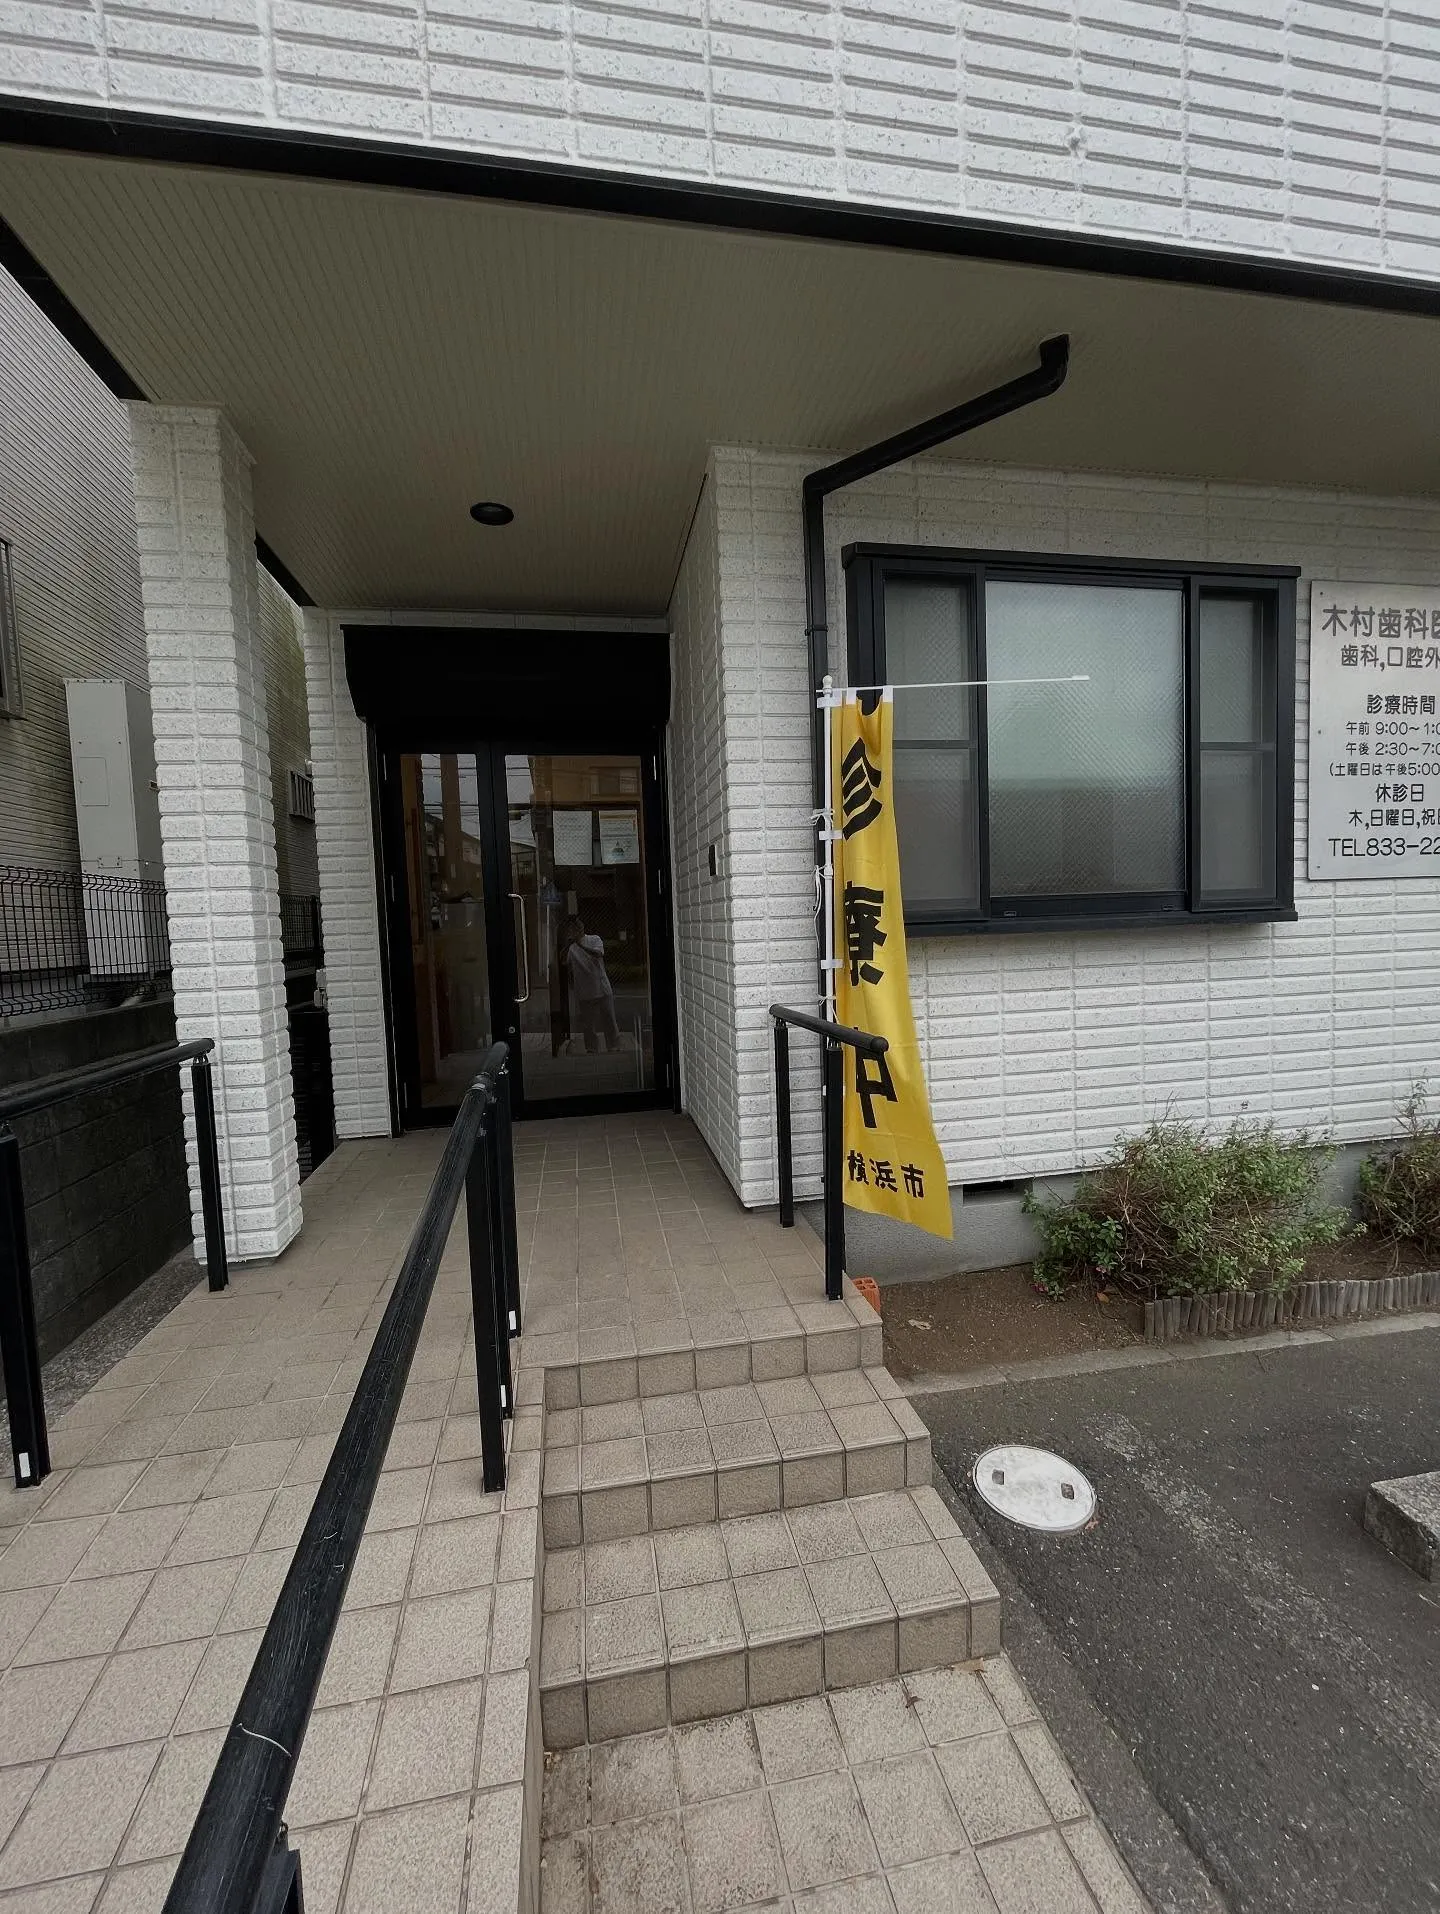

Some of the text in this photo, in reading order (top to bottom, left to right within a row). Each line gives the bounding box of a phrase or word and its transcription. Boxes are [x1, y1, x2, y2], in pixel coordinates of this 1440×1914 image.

[1367, 694, 1435, 715] 診療時間
[1346, 721, 1369, 735] 午前
[1345, 742, 1369, 756] 午後
[1375, 783, 1424, 803] 休診日
[1349, 808, 1440, 830] 木,日曜日,祝
[847, 1150, 924, 1198] 横浜市
